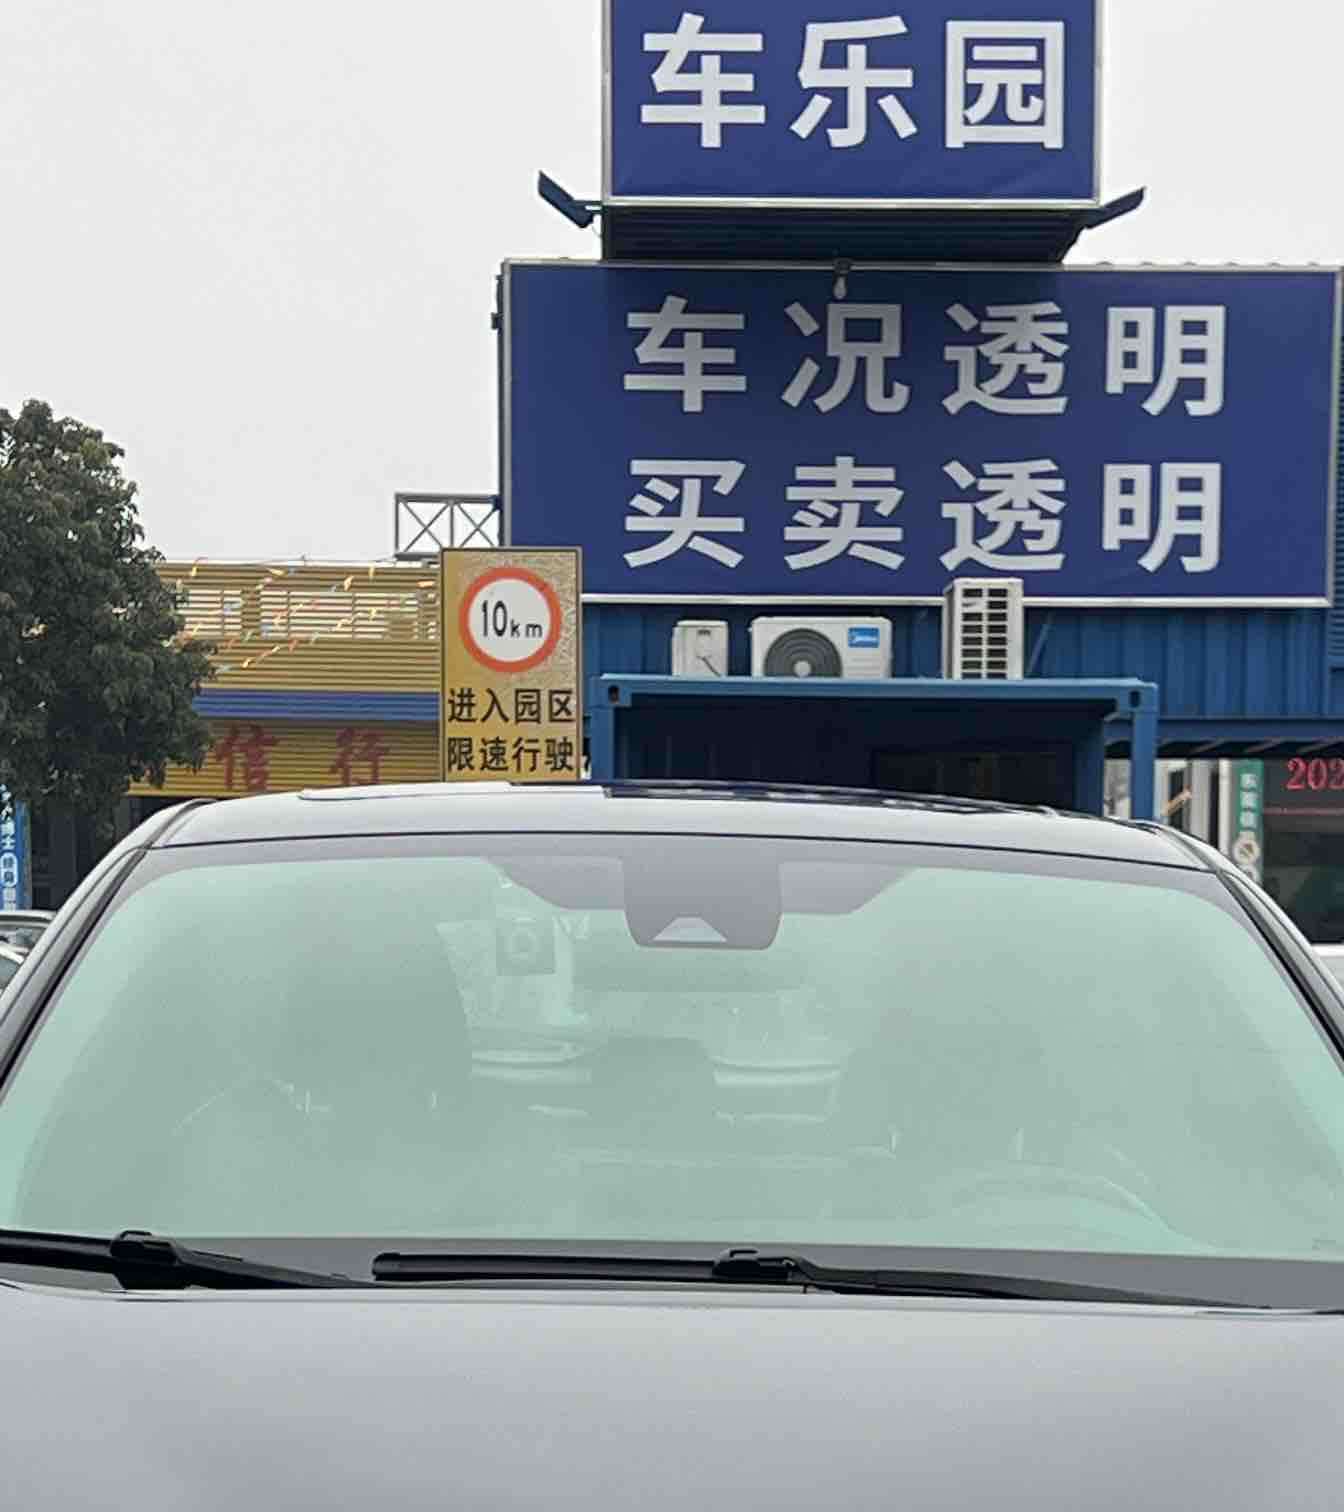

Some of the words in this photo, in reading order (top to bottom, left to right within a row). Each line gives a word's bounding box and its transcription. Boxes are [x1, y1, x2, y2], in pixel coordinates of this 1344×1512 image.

[640, 13, 1065, 149] 车乐园
[623, 295, 1227, 417] 车况透明
[623, 457, 1223, 574] 买卖透明
[481, 599, 543, 638] 10km
[447, 688, 574, 724] 进入园区
[447, 736, 574, 772] 限速行驶
